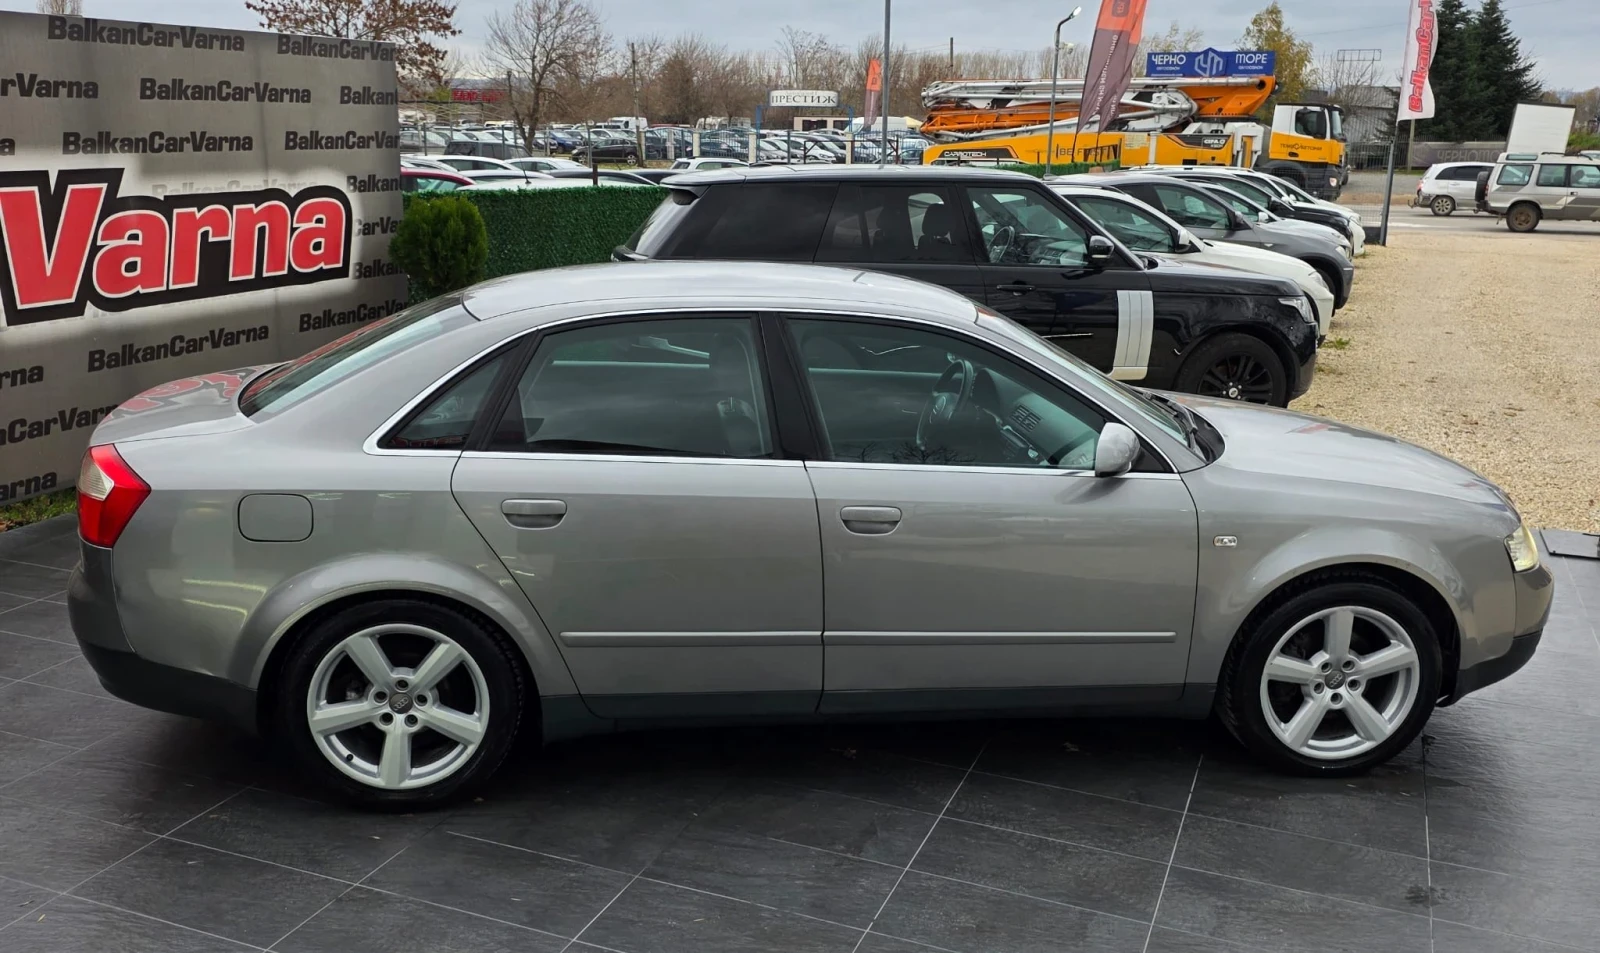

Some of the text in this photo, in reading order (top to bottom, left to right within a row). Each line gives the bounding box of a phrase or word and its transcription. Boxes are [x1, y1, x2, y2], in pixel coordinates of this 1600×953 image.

[48, 16, 245, 51] BalkanCarVarna
[1152, 53, 1268, 65] ЧЕРНО МОРЕ
[0, 73, 99, 99] rVarna
[140, 77, 311, 104] BalkanCarVarna
[340, 85, 398, 105] Balkan
[771, 95, 836, 104] ПРЕСТИЖ
[62, 130, 253, 155] BalkanCarVarna
[1437, 149, 1503, 161] ЧЕРНОМО
[346, 174, 401, 193] Balkan
[354, 216, 402, 236] CarVa
[0, 182, 347, 310] Varna
[88, 325, 269, 373] BalkanCarVarna
